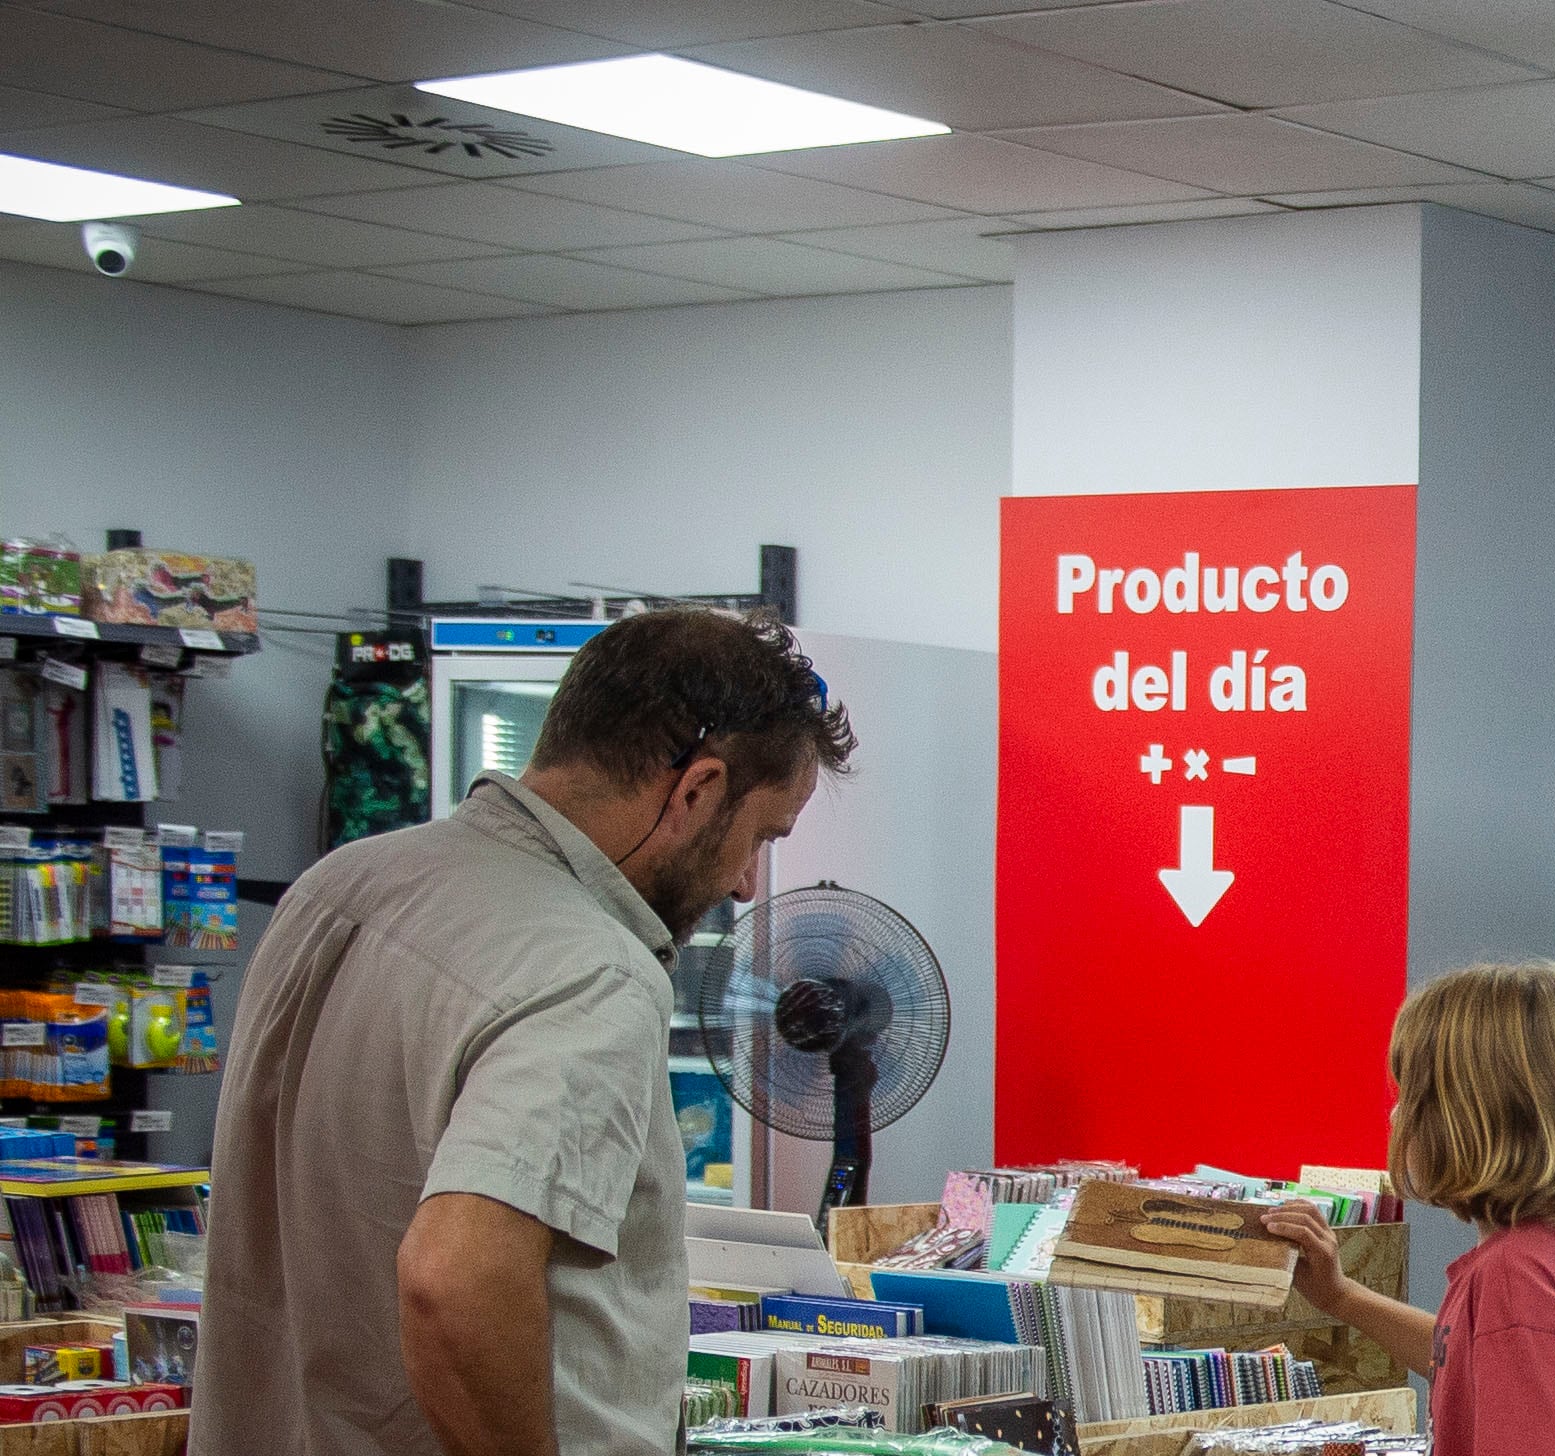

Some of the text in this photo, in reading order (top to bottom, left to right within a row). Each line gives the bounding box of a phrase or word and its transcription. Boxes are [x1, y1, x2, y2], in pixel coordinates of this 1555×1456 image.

[1057, 550, 1349, 614] Producto
[1092, 649, 1307, 712] del día
[786, 1377, 890, 1406] CAZADORES
